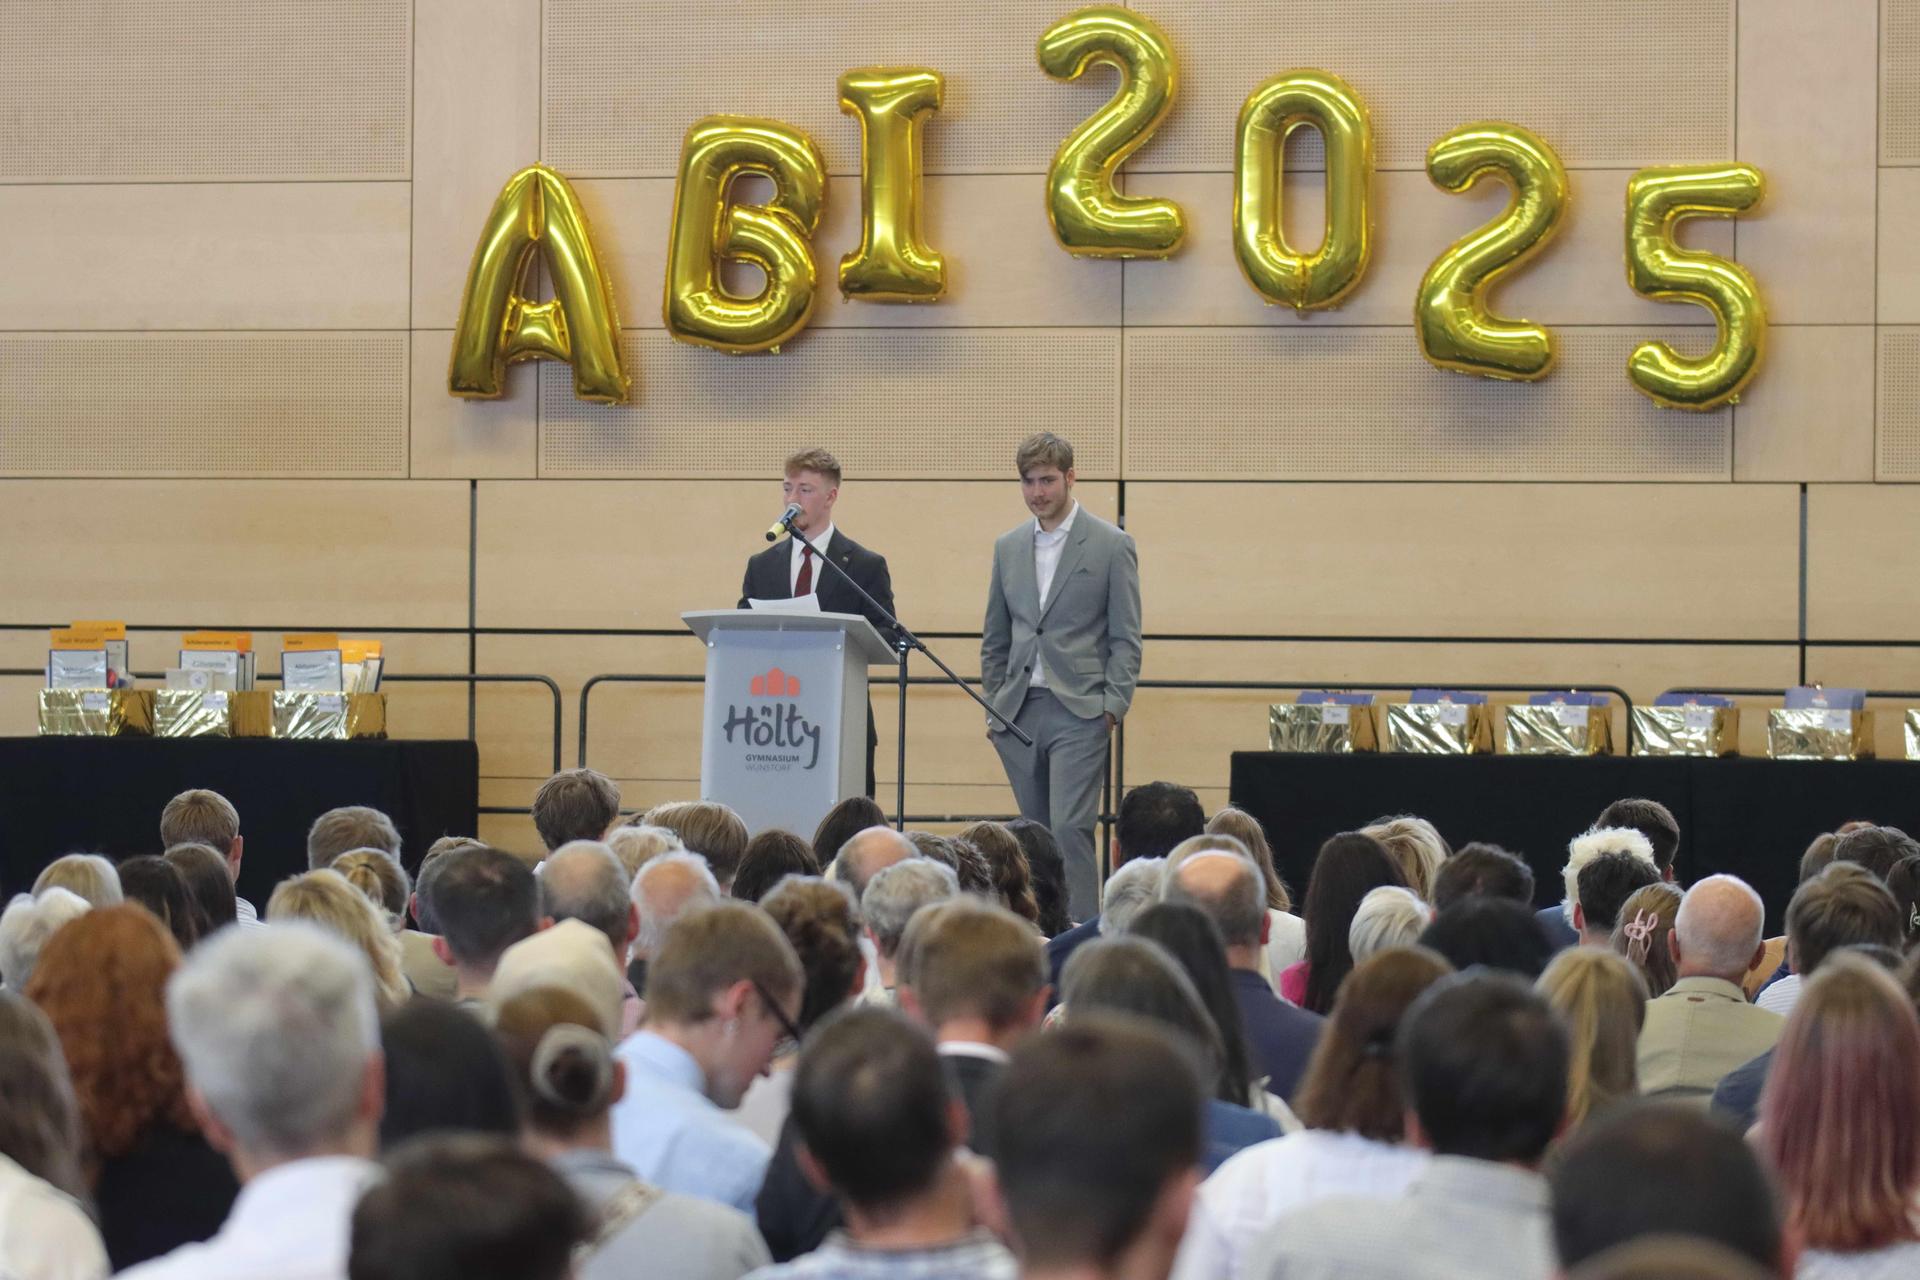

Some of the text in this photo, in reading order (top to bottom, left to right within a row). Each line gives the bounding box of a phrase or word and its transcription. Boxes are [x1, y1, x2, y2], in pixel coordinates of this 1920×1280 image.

[448, 4, 1768, 411] ABI 2025
[723, 703, 820, 769] Hölty
[745, 753, 800, 762] GYMNASIUM
[745, 764, 791, 772] WUNSTORF
